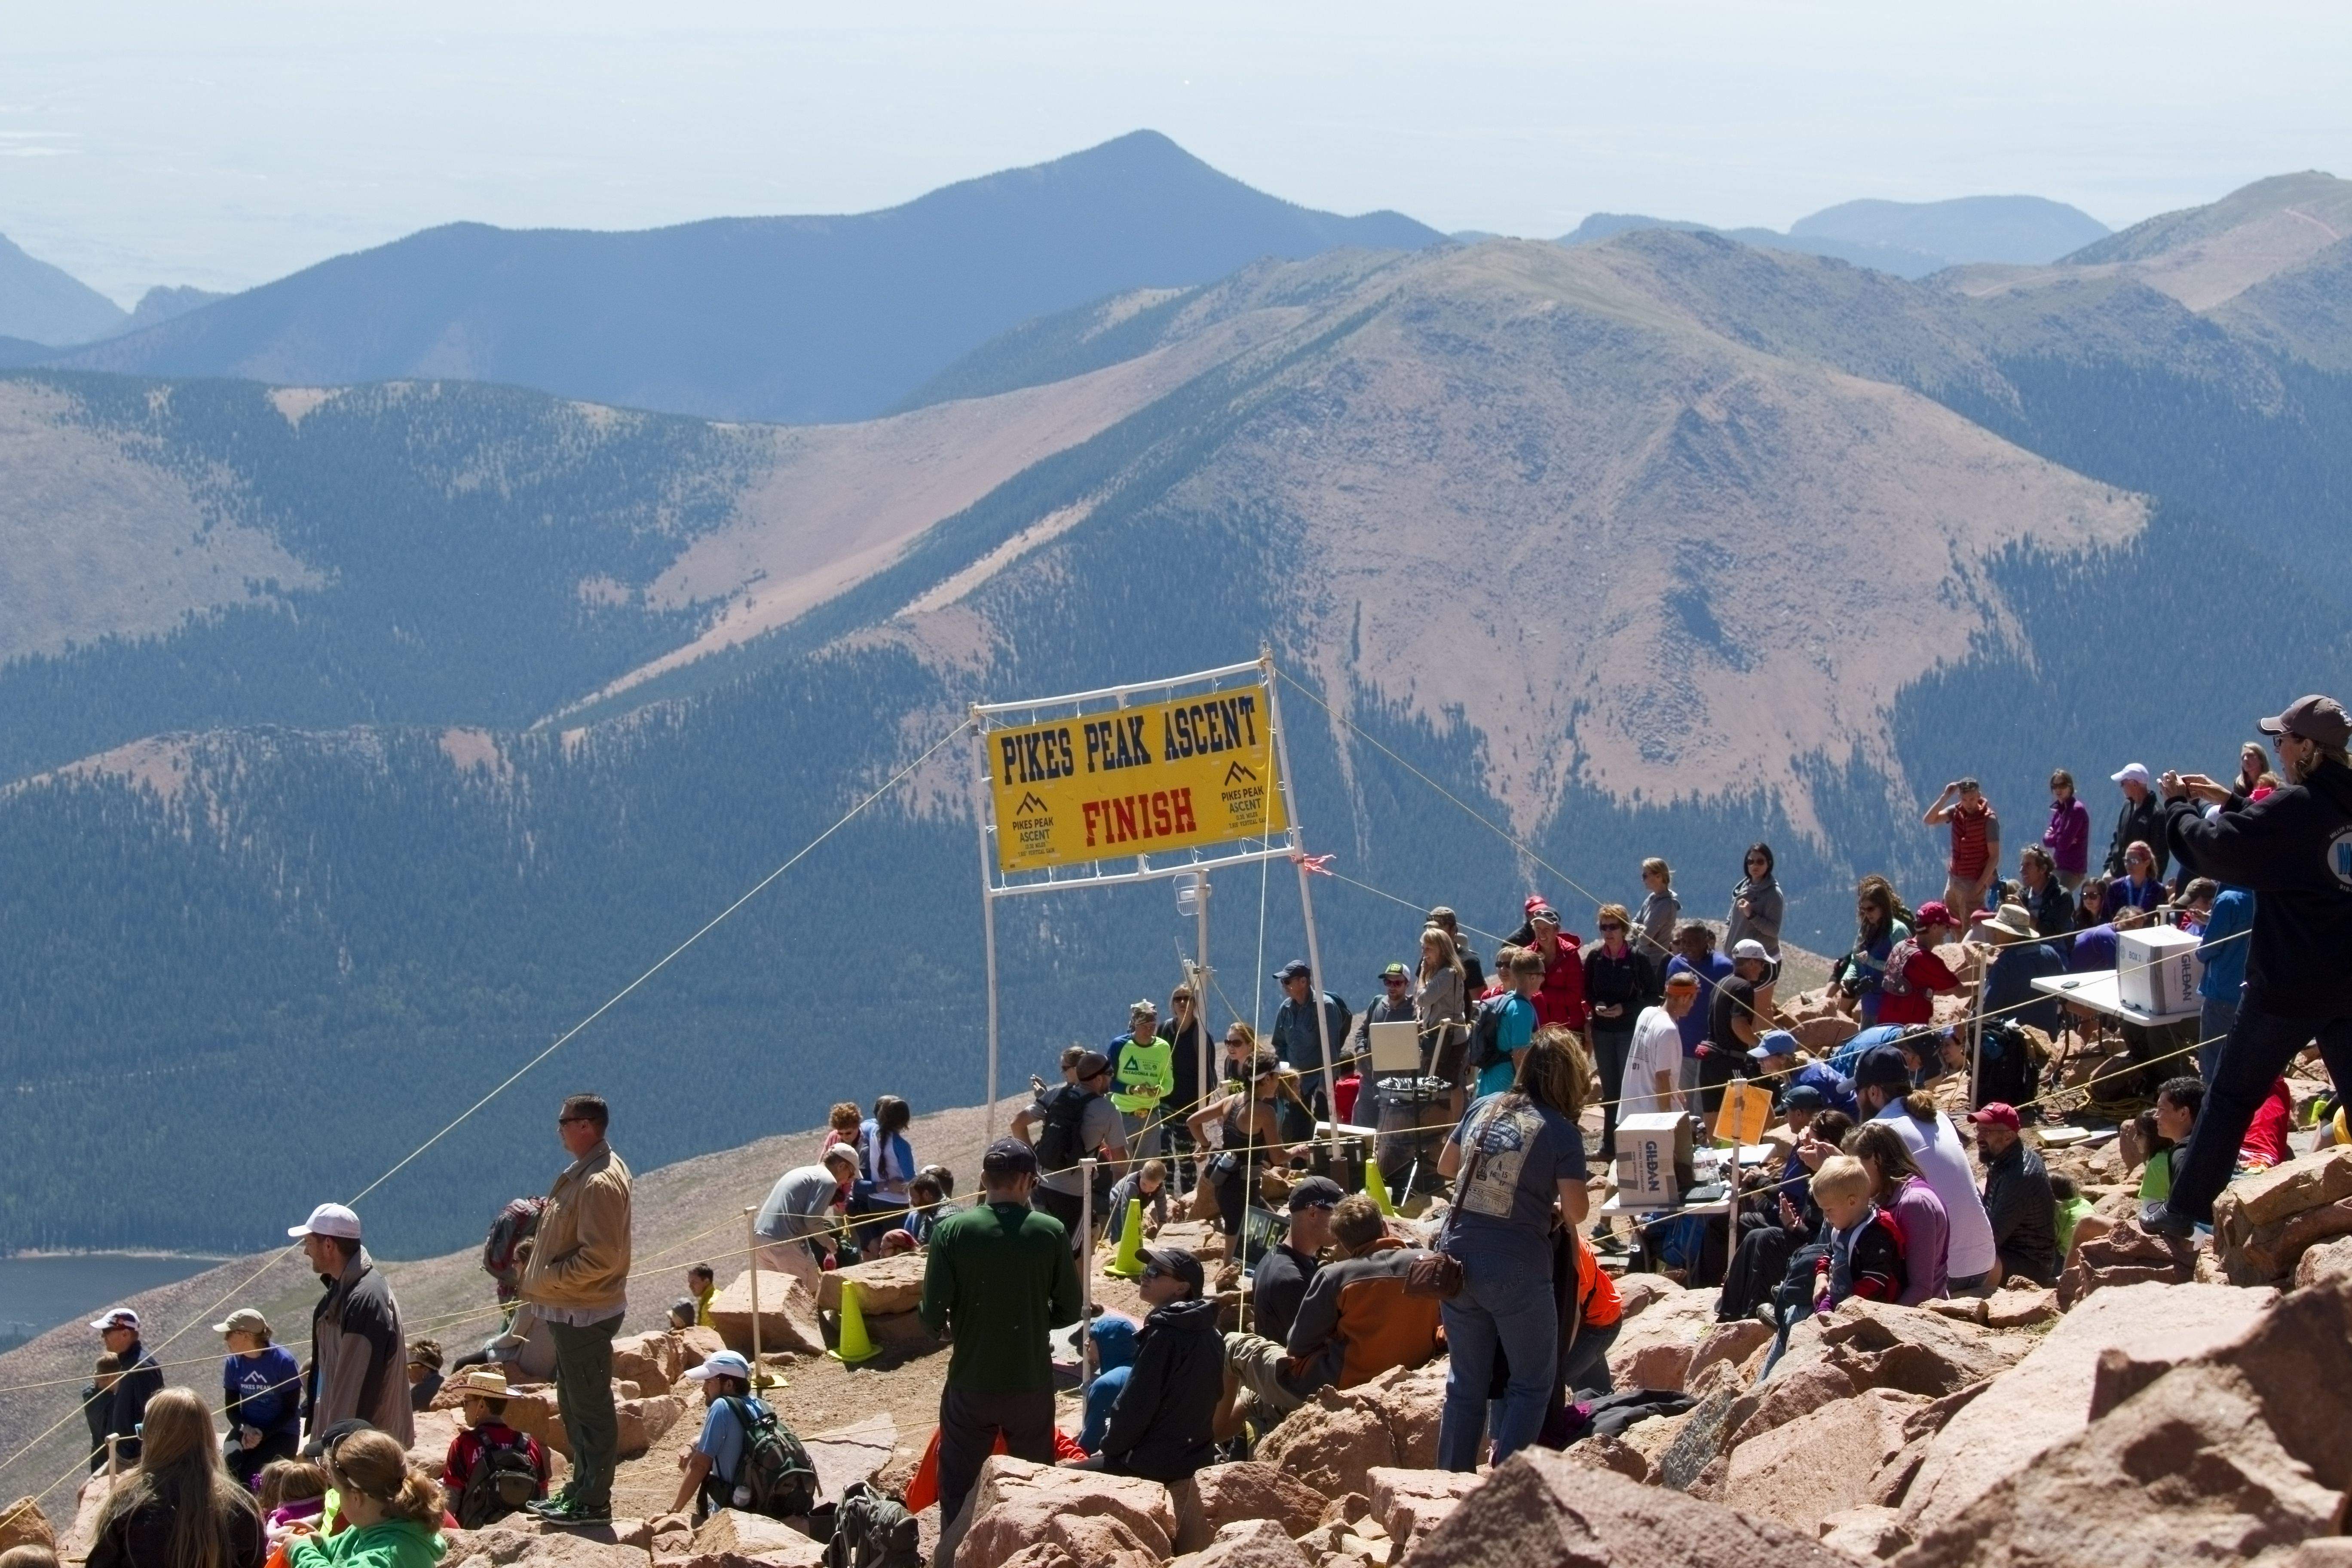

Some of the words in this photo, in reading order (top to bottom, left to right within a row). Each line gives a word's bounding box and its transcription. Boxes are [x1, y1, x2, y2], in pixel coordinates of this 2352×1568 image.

[1001, 727, 1074, 786] PIKES
[1084, 715, 1152, 773] PEAK
[1164, 696, 1256, 761] ASCENT
[1222, 790, 1241, 802] PIKES
[1243, 786, 1264, 798] PEAK
[1230, 798, 1261, 813] ASCENT
[1012, 819, 1032, 830] PIKES
[1034, 817, 1054, 828] PEAK
[1082, 787, 1197, 847] FINISH
[1240, 818, 1258, 827] VERTICAL
[1020, 829, 1050, 842] ASCENT
[2330, 826, 2345, 839] MILLER
[2339, 884, 2352, 893] 918-
[2128, 951, 2138, 961] BOX
[2138, 954, 2141, 962] 3
[2181, 954, 2192, 1001] GILDAN
[1494, 1124, 1511, 1133] GOOSE
[1509, 1131, 1519, 1140] VII
[1645, 1140, 1660, 1191] GILDAN
